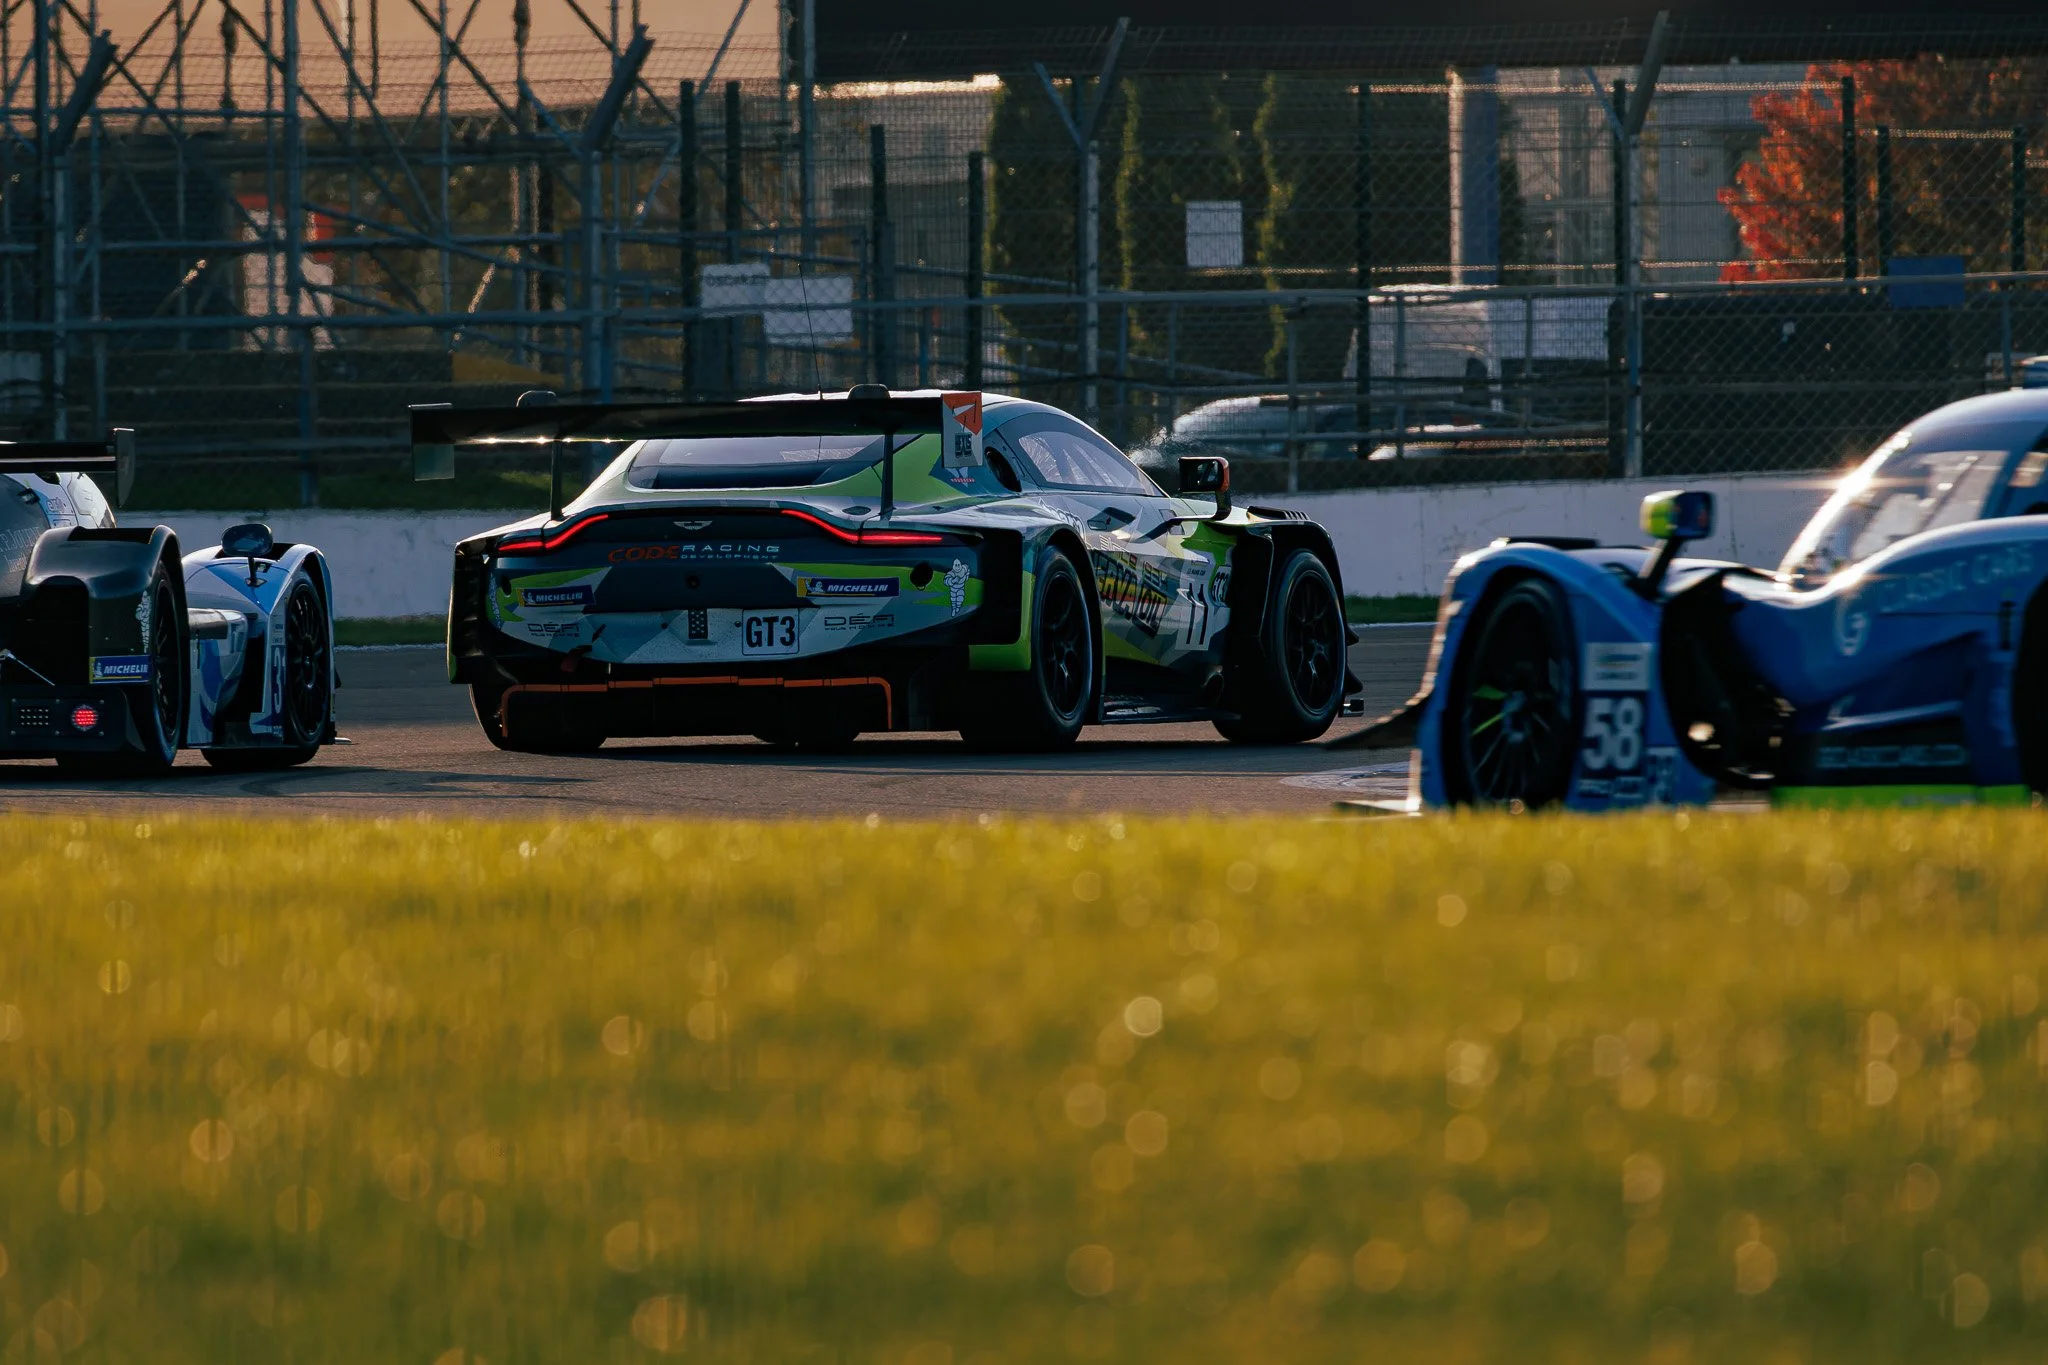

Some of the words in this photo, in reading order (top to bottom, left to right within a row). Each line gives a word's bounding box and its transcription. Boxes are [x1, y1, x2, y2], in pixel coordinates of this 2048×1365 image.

[608, 545, 680, 563] CODE
[682, 544, 781, 553] RACING
[535, 592, 583, 602] MICHELIN
[827, 584, 889, 592] MICHELIN
[1186, 582, 1208, 645] 11
[746, 616, 796, 648] GT3
[104, 665, 149, 674] MICHELIN
[1582, 697, 1643, 771] 58
